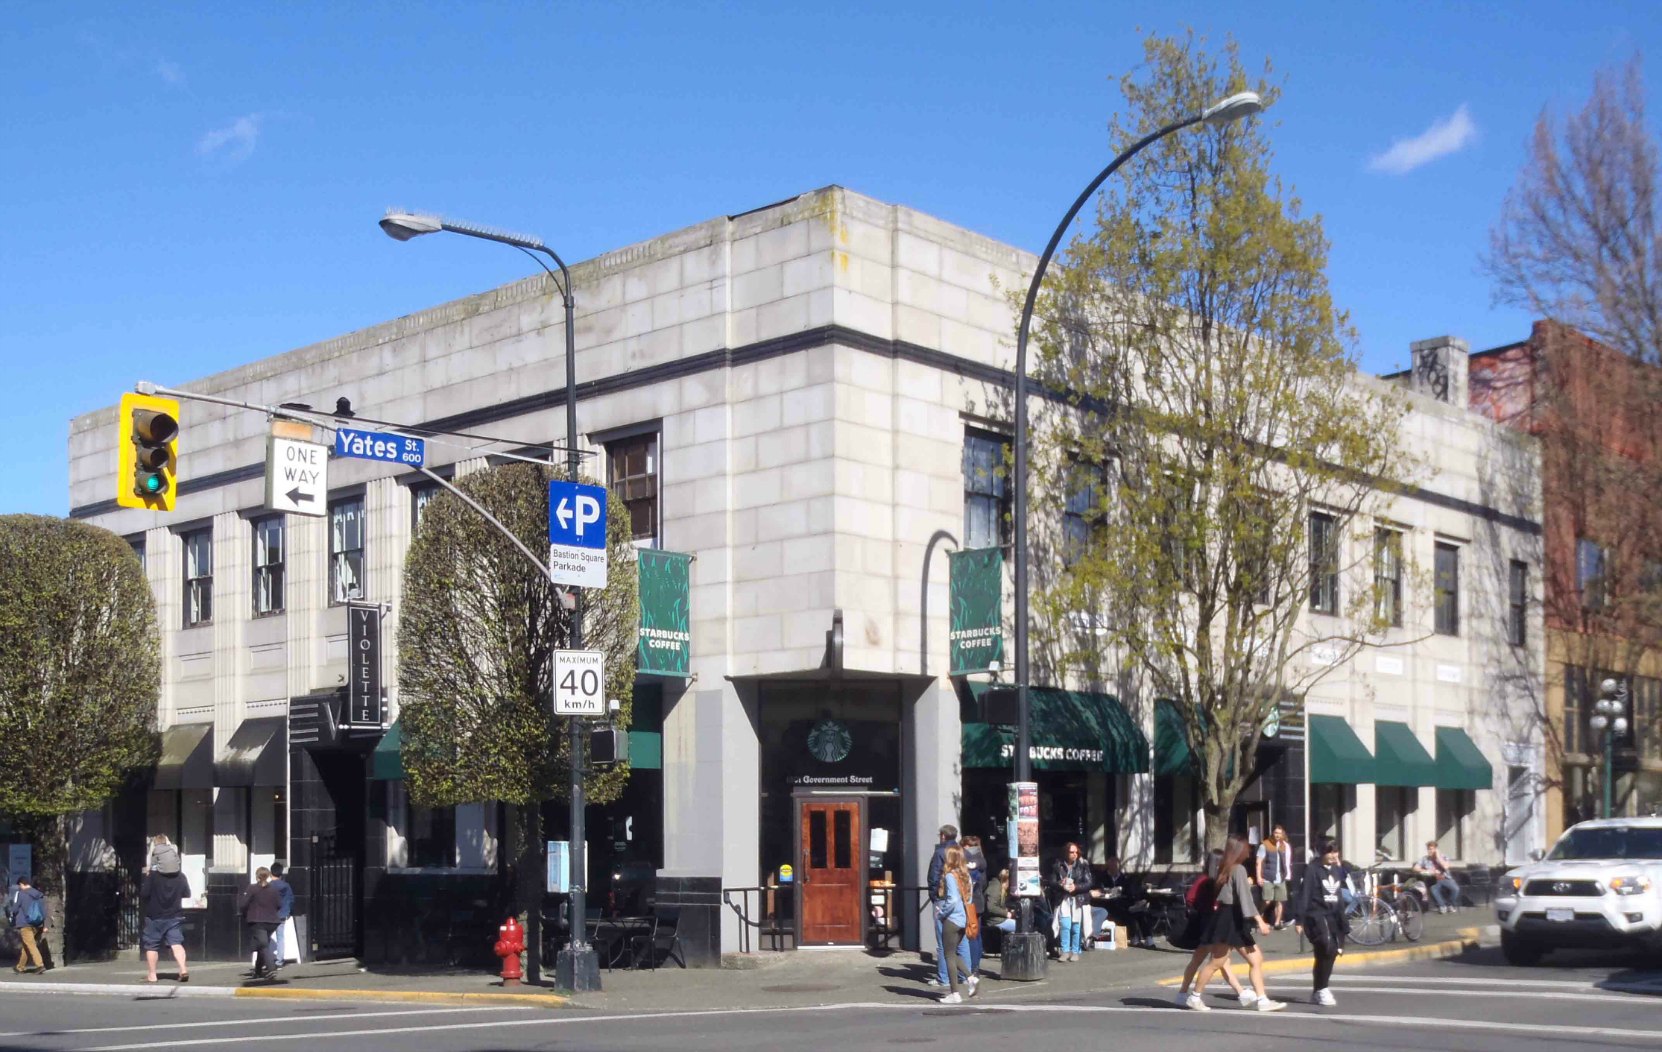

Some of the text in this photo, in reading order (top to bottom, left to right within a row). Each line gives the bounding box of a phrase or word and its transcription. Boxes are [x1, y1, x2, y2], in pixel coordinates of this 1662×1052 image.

[339, 432, 420, 459] Yates St.
[286, 446, 318, 465] ONE
[402, 454, 421, 463] 600
[284, 467, 319, 485] WAY
[575, 495, 600, 536] P
[553, 549, 604, 564] Bastion Square
[553, 561, 586, 573] Parkade
[639, 628, 690, 641] STARBUCKS
[950, 627, 1001, 640] STARBUCKS
[649, 639, 681, 651] COFFEE
[960, 638, 992, 649] COFFEE
[360, 610, 371, 721] VIOLETTE
[560, 669, 599, 697] 40
[564, 700, 595, 709] km/h
[1001, 745, 1104, 762] STBUCKS COFFEE
[803, 775, 848, 784] Government
[849, 775, 873, 784] Street
